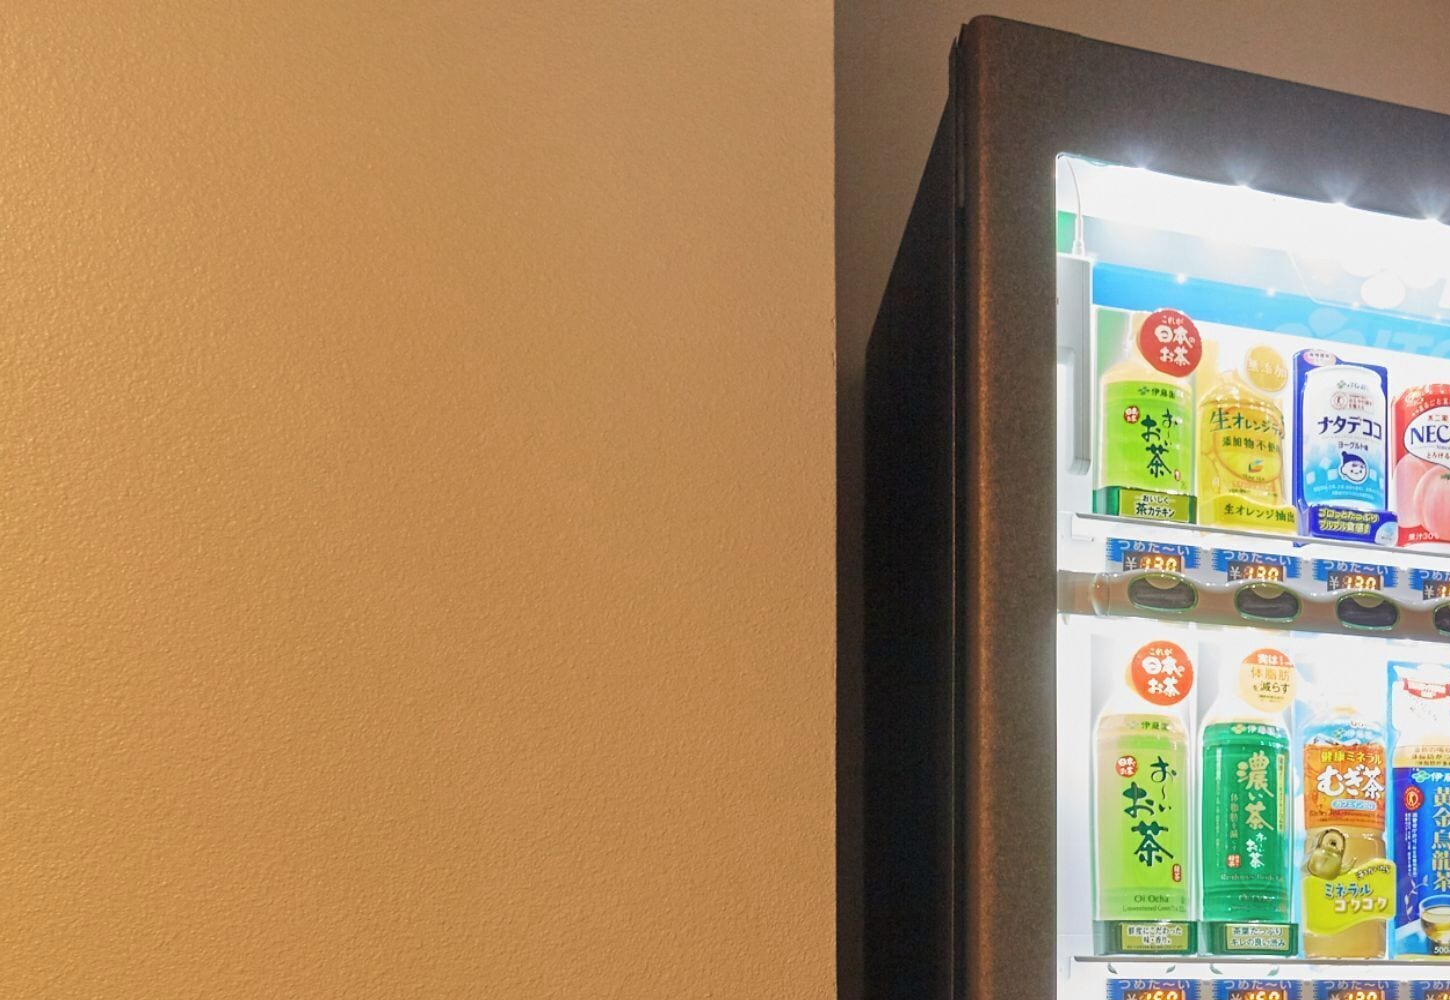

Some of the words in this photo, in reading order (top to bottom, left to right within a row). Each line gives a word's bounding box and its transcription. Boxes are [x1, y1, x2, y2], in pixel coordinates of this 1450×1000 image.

[1160, 346, 1190, 366] お茶
[1318, 415, 1382, 440] ナタデココ
[1136, 503, 1175, 518] 茶カテキン
[1147, 676, 1180, 697] お茶
[1317, 764, 1386, 799] むぎ茶
[1325, 883, 1372, 899] ミネラル
